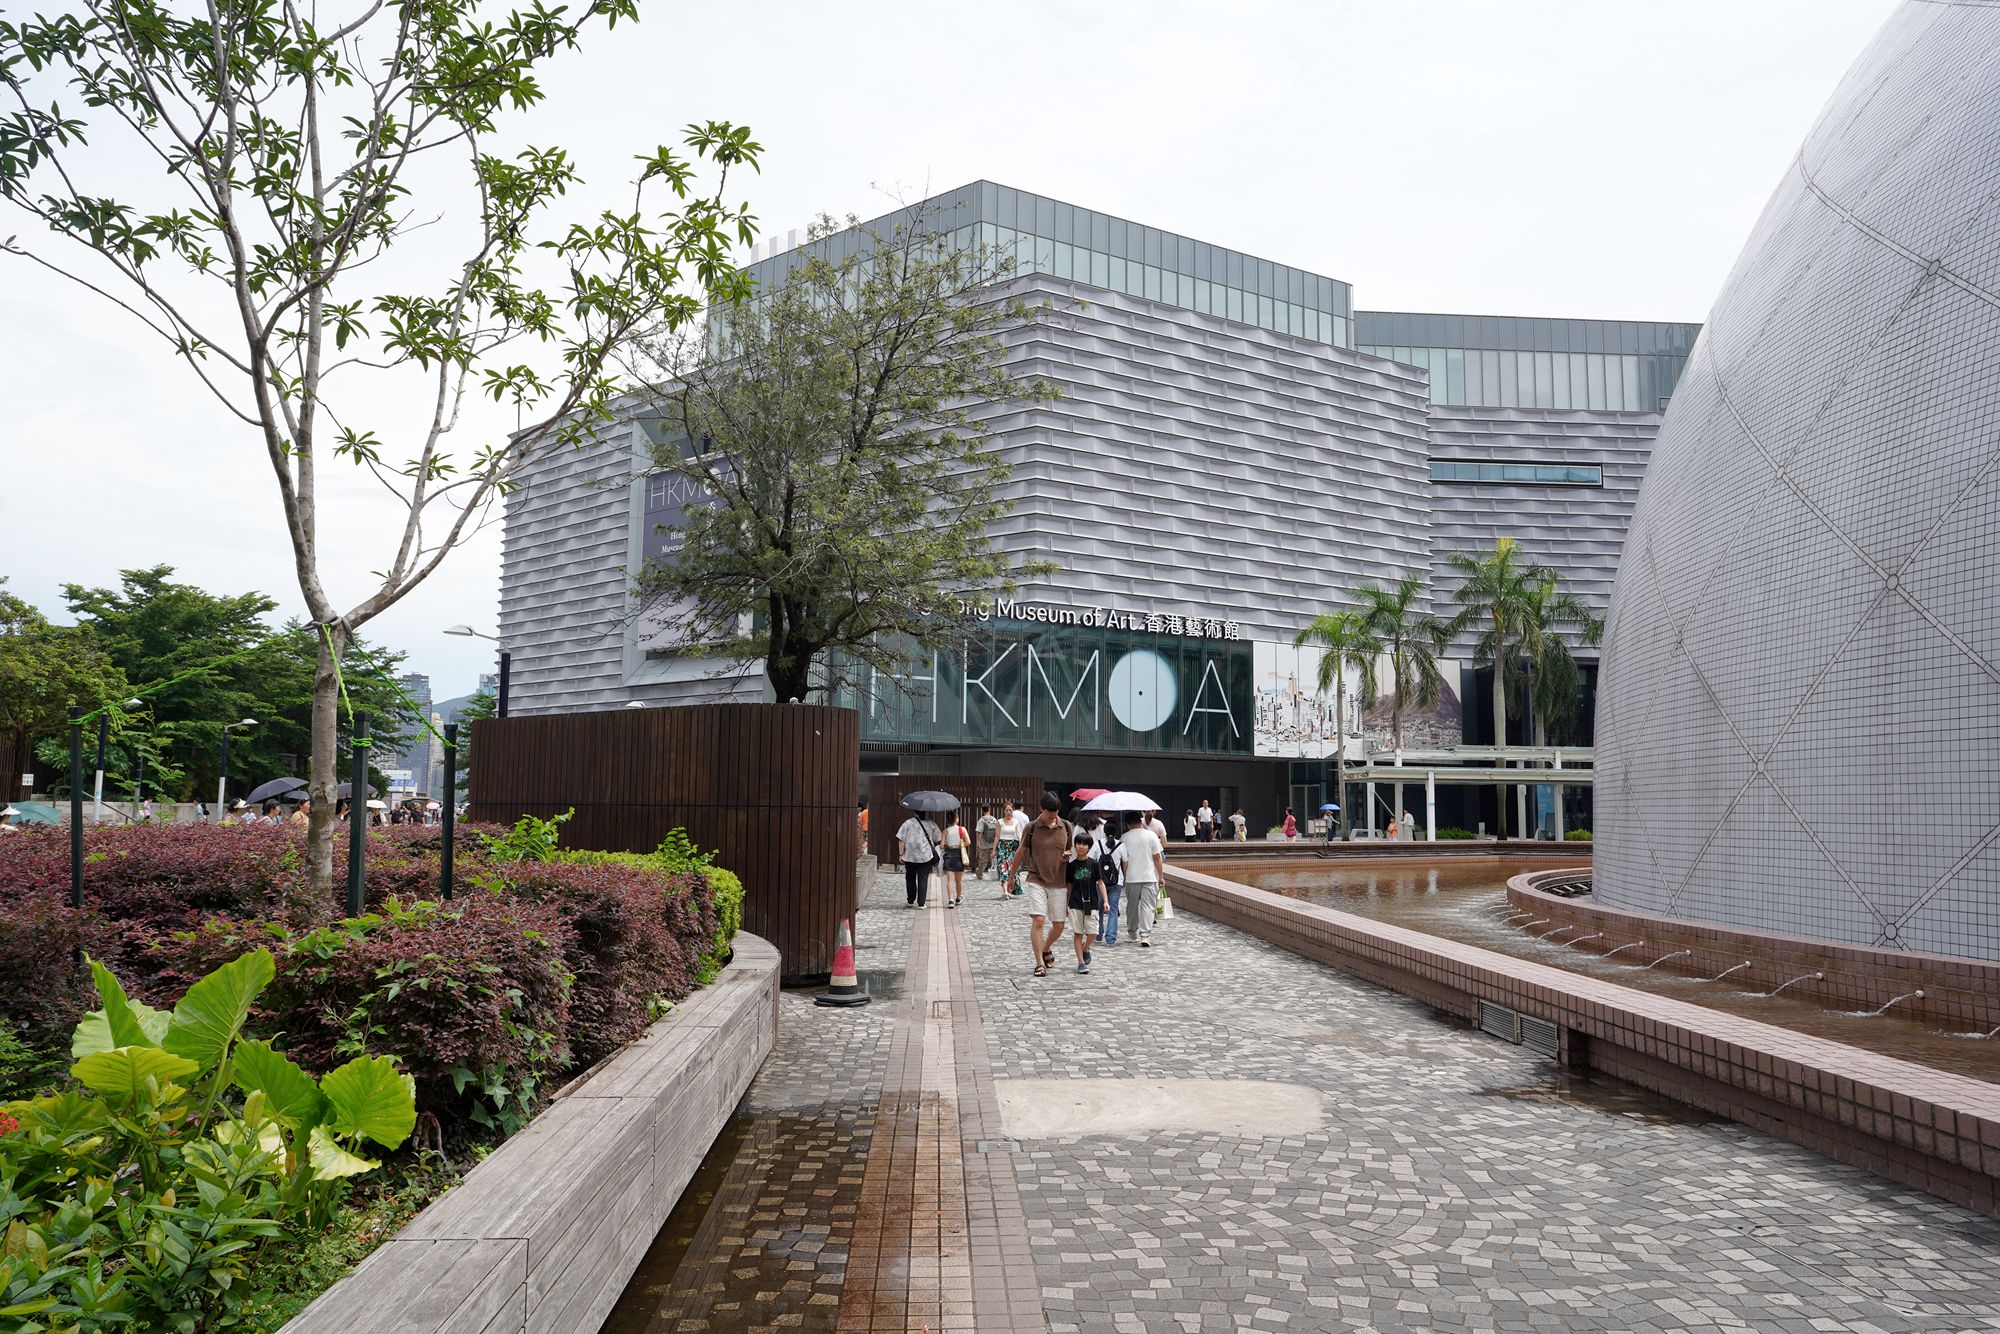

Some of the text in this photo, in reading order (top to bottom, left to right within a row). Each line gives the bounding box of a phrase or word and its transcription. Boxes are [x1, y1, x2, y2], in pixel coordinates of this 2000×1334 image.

[940, 592, 990, 621] ong
[997, 597, 1078, 625] Museum
[1082, 607, 1102, 627] of
[1106, 609, 1137, 631] Art
[1145, 612, 1240, 642] 香港藝術館
[870, 630, 1240, 739] HKMOA
